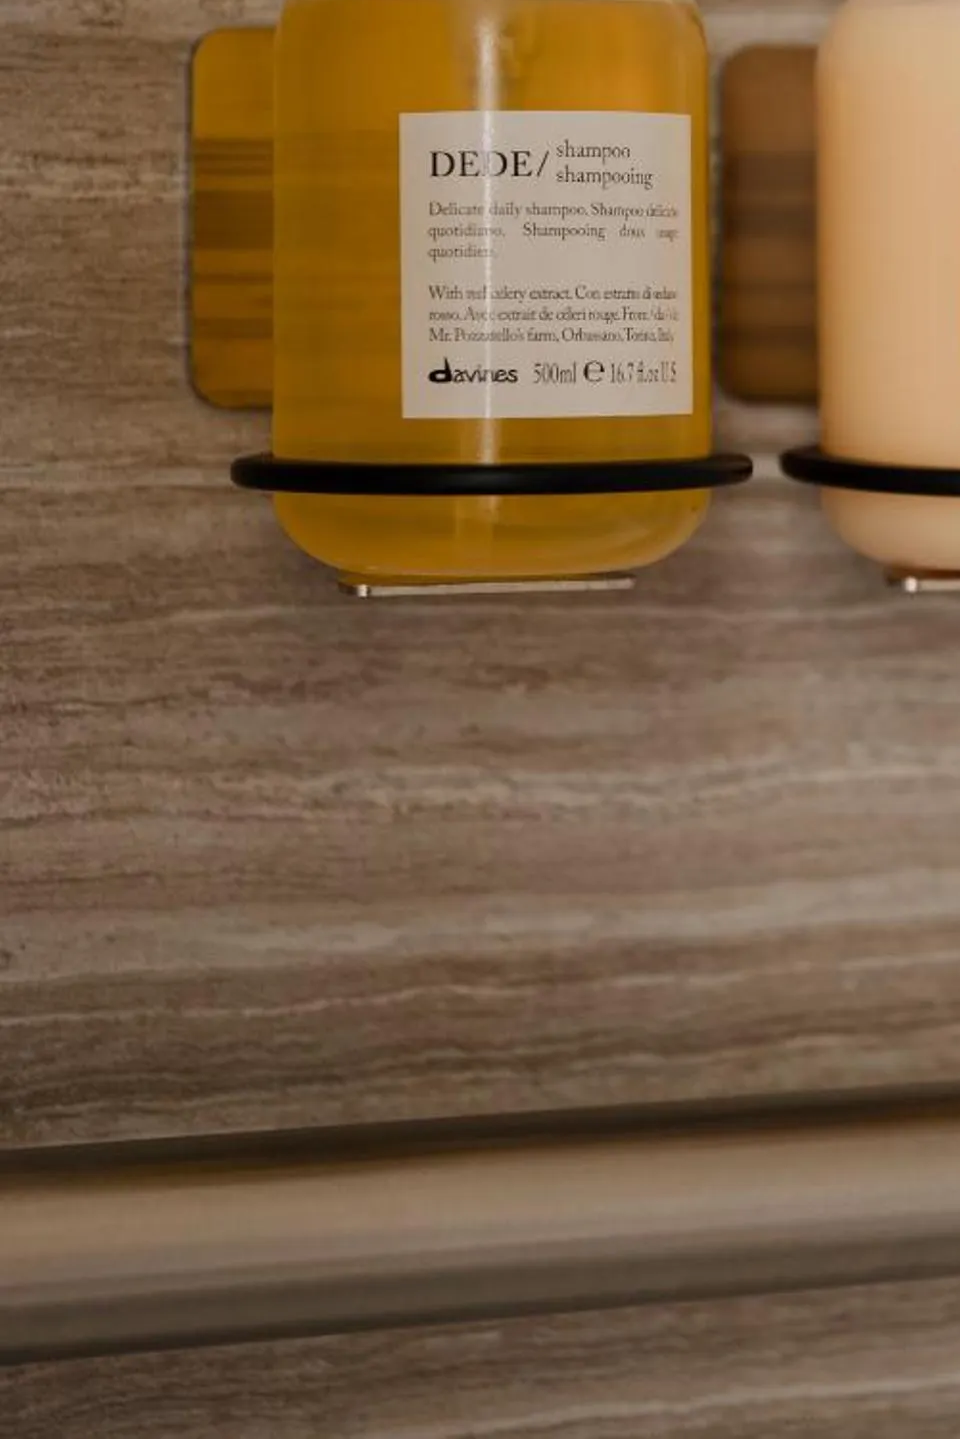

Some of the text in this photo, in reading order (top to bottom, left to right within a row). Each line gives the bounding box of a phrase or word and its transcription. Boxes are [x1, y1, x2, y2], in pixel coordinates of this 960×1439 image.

[556, 139, 631, 166] shampoo
[556, 164, 654, 191] shampooing
[489, 201, 521, 219] daily
[590, 201, 644, 221] Shampoo
[522, 221, 606, 242] Shampooing
[428, 284, 463, 300] With
[428, 356, 519, 383] davines
[533, 361, 577, 384] 500ml
